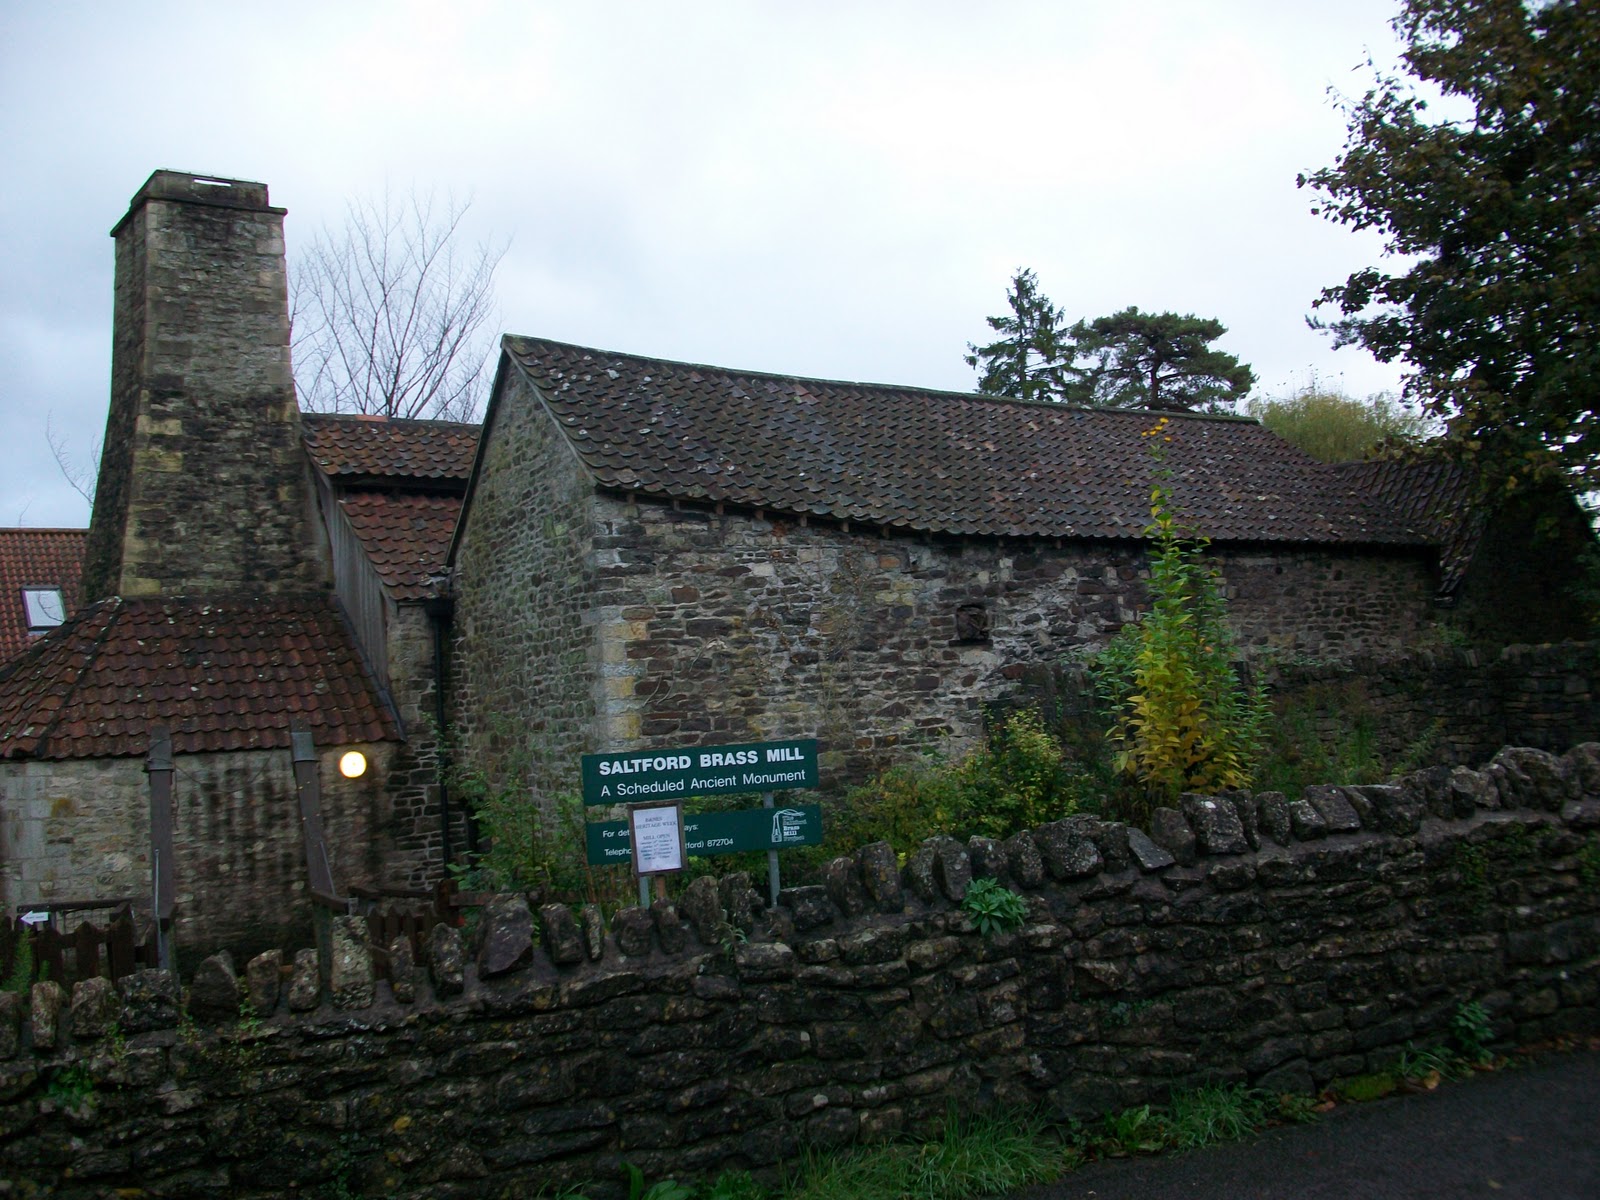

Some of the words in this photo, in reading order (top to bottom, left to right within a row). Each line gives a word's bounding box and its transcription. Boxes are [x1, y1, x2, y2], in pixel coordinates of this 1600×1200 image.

[599, 755, 692, 776] SALTFORD
[700, 749, 759, 768] BRASS
[766, 747, 805, 763] MILL
[601, 785, 611, 797] A
[617, 778, 685, 796] Scheduled
[690, 774, 737, 789] Ancient
[743, 769, 806, 785] Monument
[602, 830, 615, 838] For
[617, 829, 630, 837] det
[683, 823, 699, 832] ays:
[604, 847, 632, 857] Telepho
[684, 840, 704, 849] tford)
[707, 838, 734, 847] 872704
